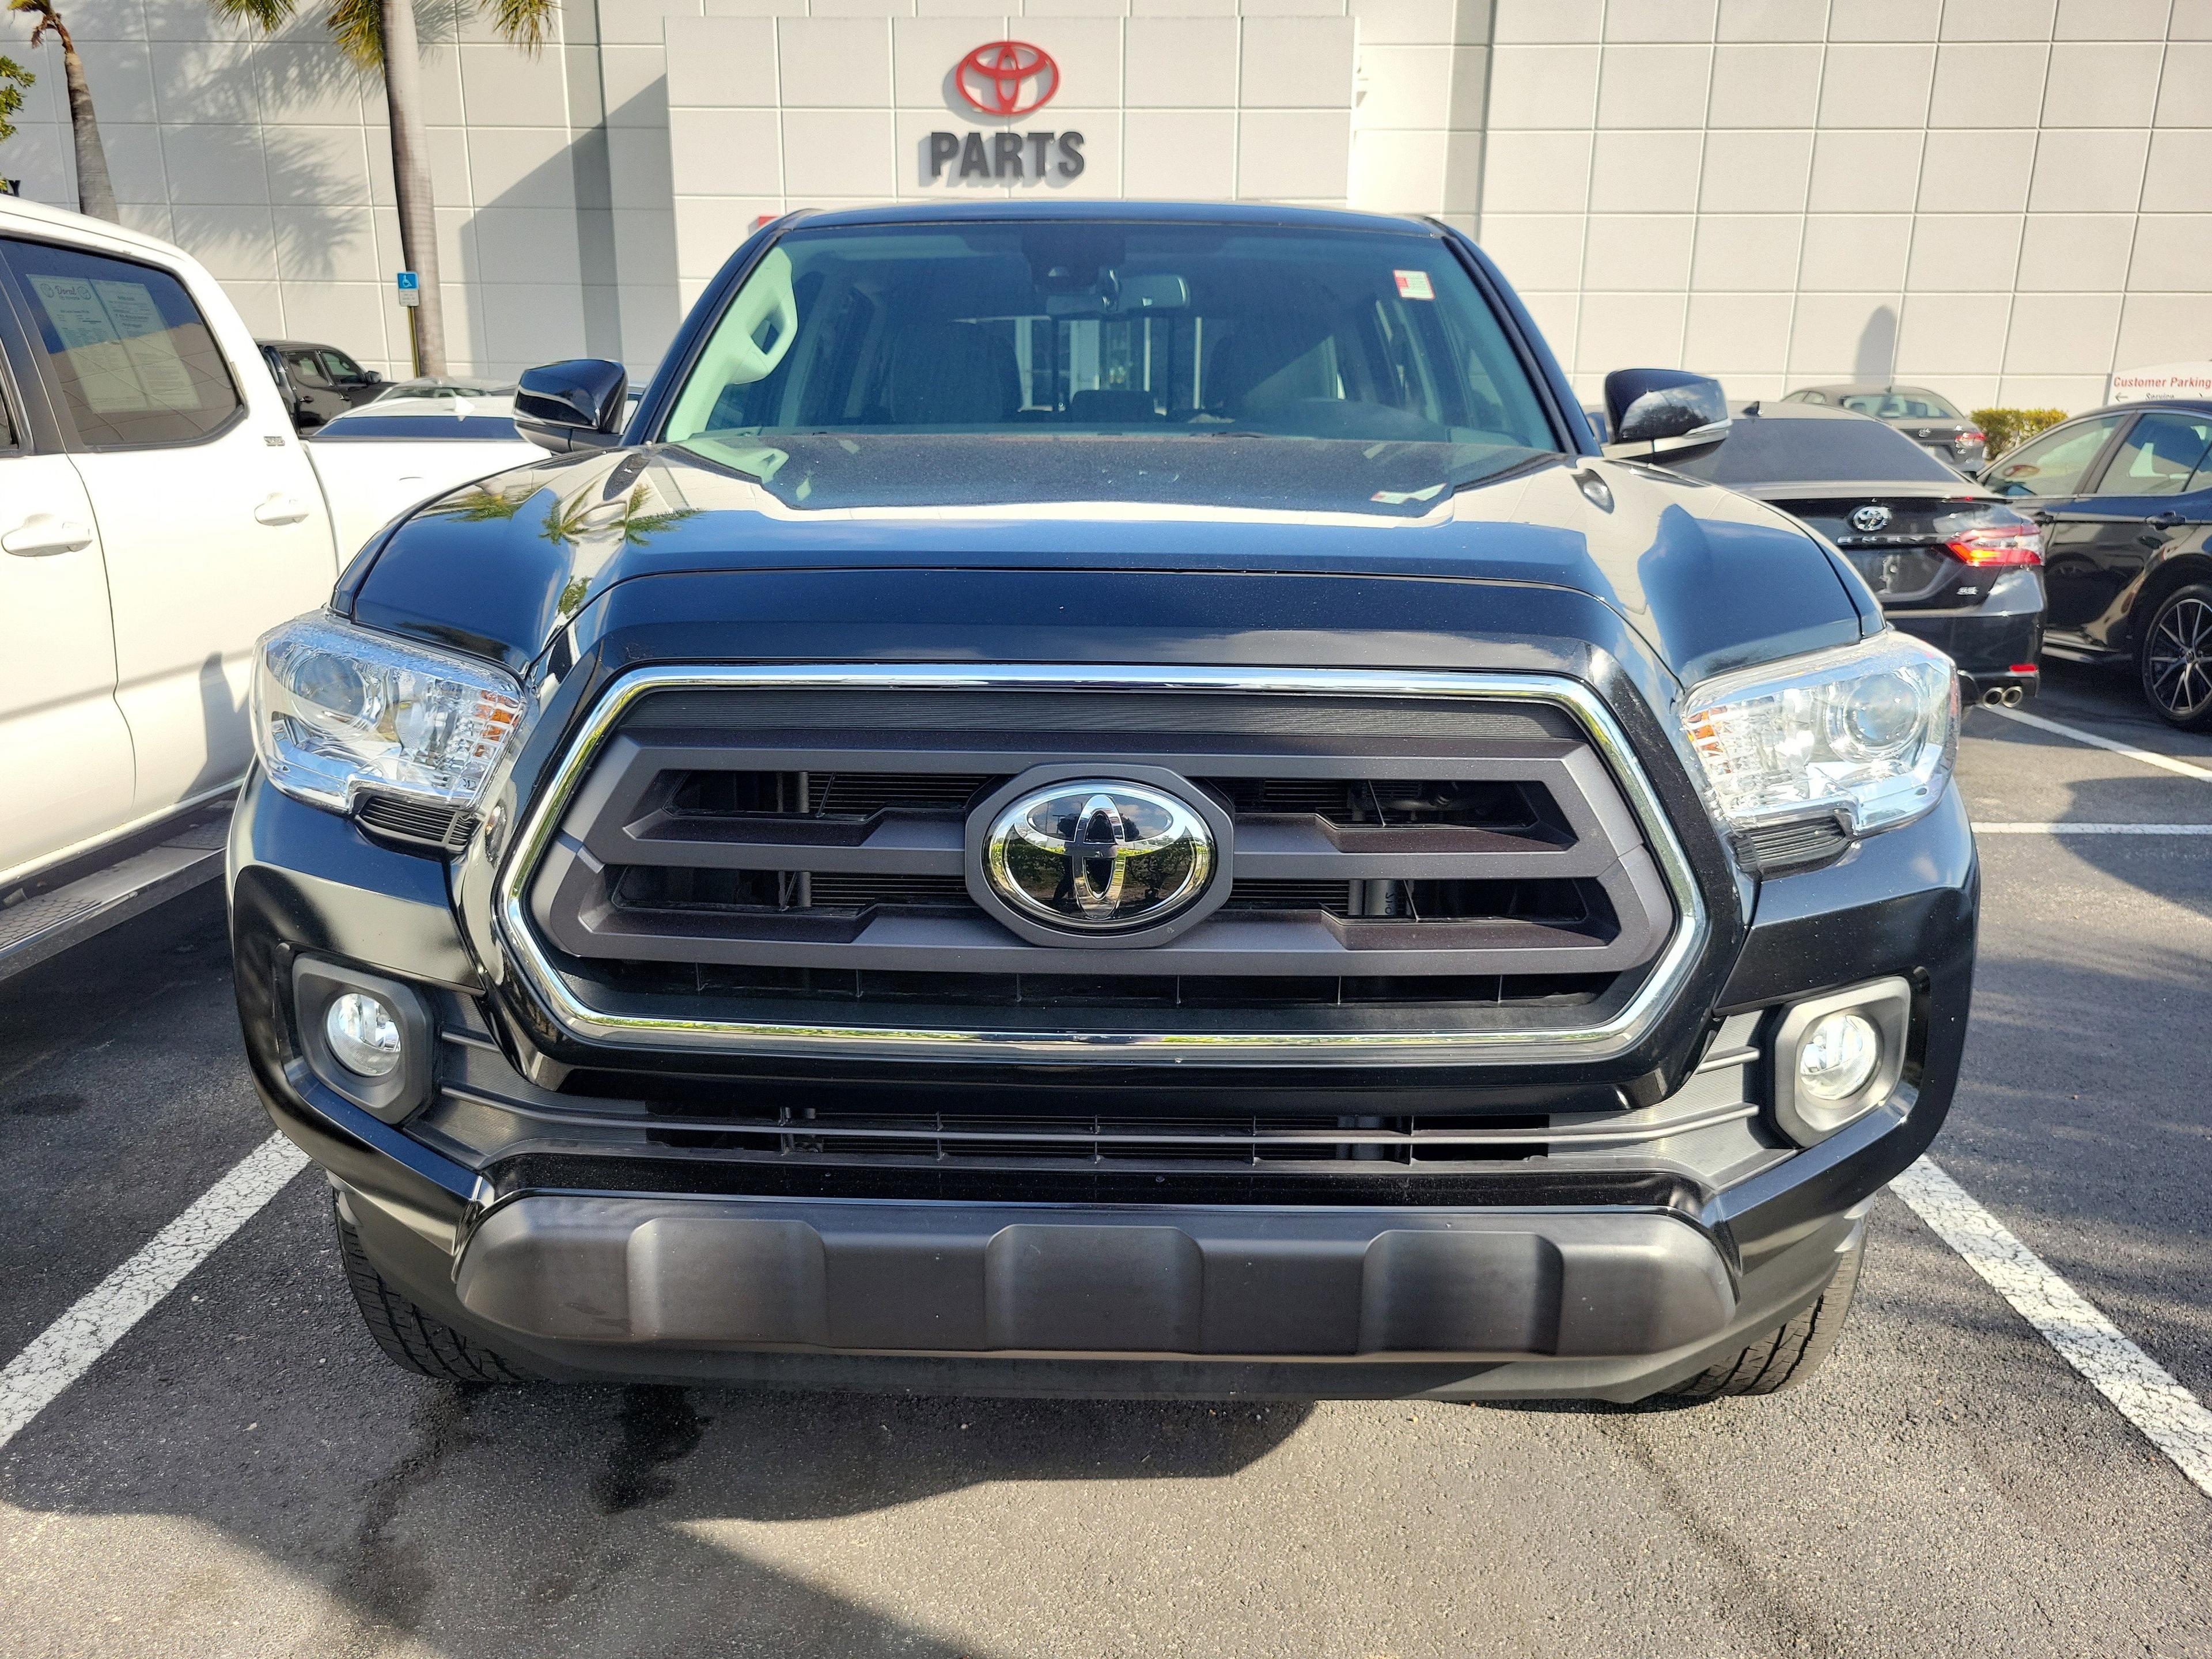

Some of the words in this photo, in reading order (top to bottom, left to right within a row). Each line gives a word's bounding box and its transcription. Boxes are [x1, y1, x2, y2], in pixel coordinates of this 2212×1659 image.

[931, 131, 1085, 179] PARTS
[2113, 376, 2166, 388] Customer
[2170, 376, 2211, 389] Parking
